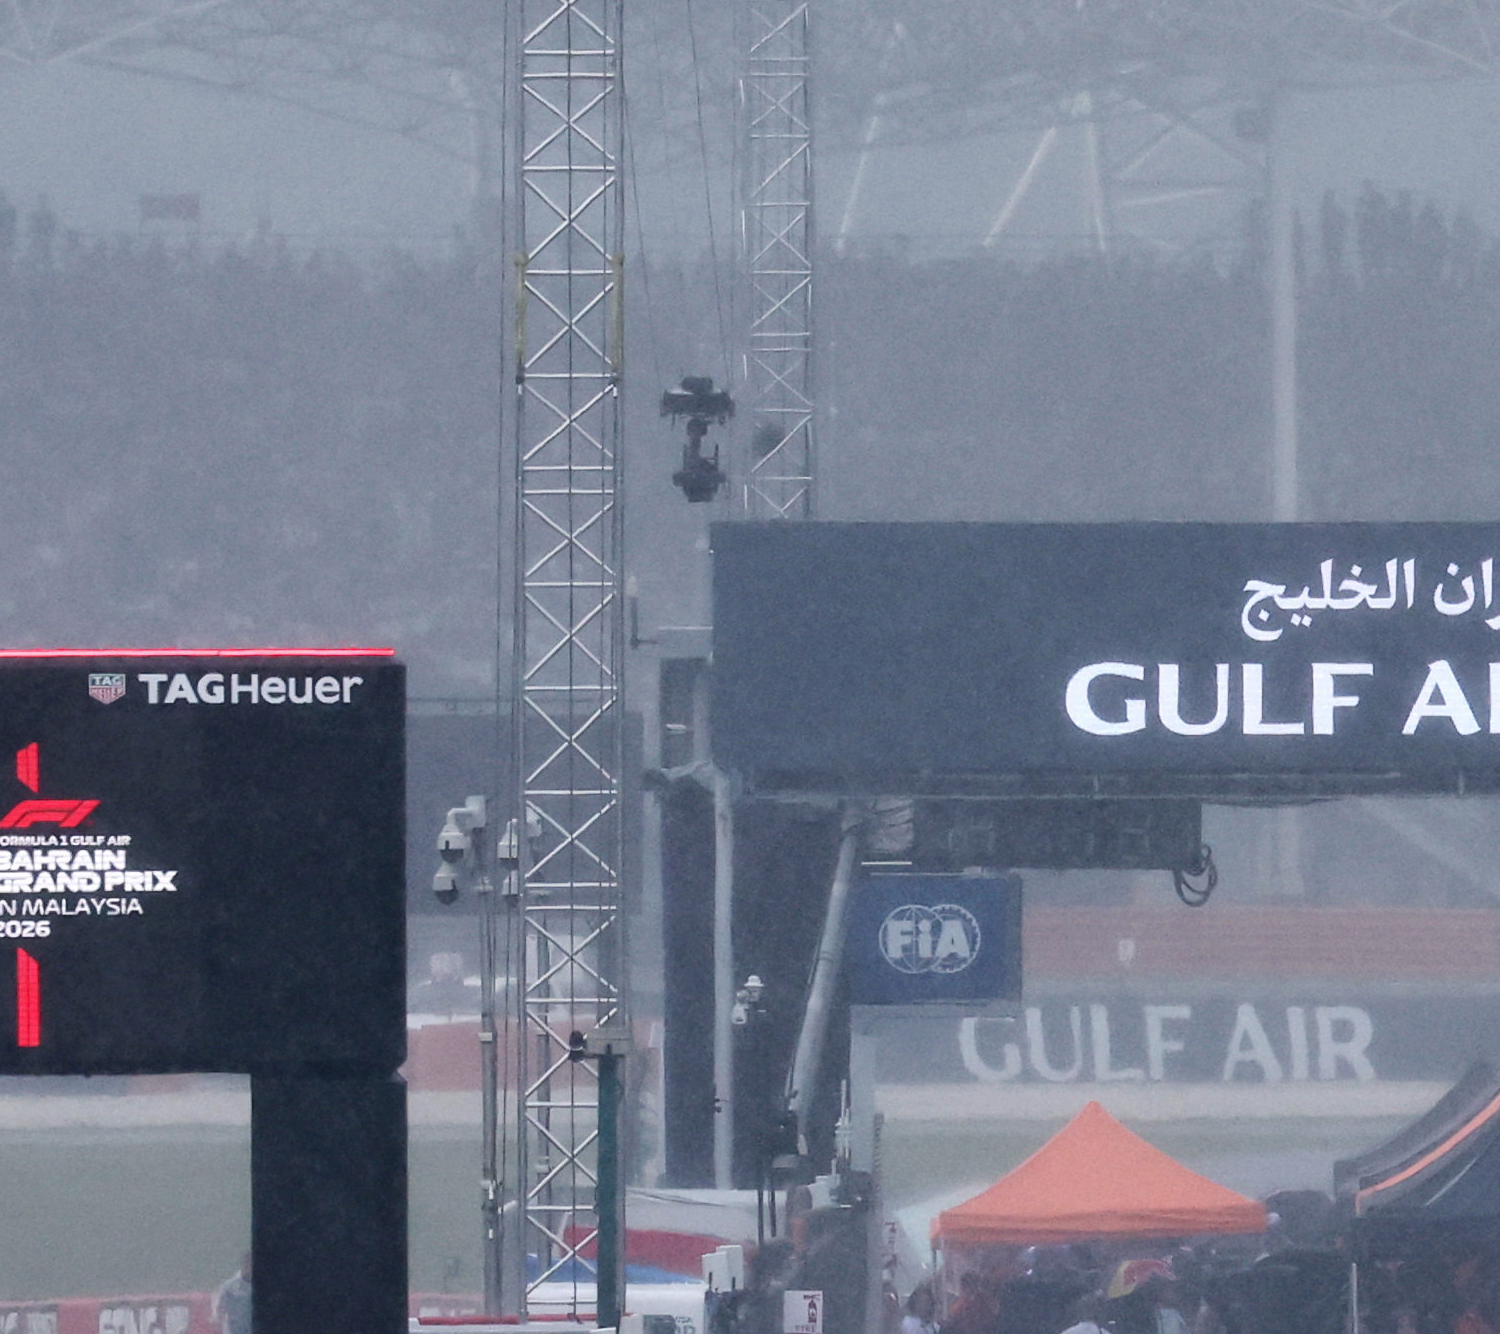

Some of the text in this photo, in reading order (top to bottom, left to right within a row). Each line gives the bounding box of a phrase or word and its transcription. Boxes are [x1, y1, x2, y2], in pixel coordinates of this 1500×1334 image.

[1241, 557, 1415, 641] الخليج
[1065, 661, 1374, 736] GULF
[60, 835, 70, 847] 1
[70, 835, 105, 847] GULF
[107, 835, 131, 847] AIR
[104, 870, 179, 892] PRIX
[21, 897, 144, 916] MALAYSIA
[958, 1002, 1378, 1083] GULF AIR
